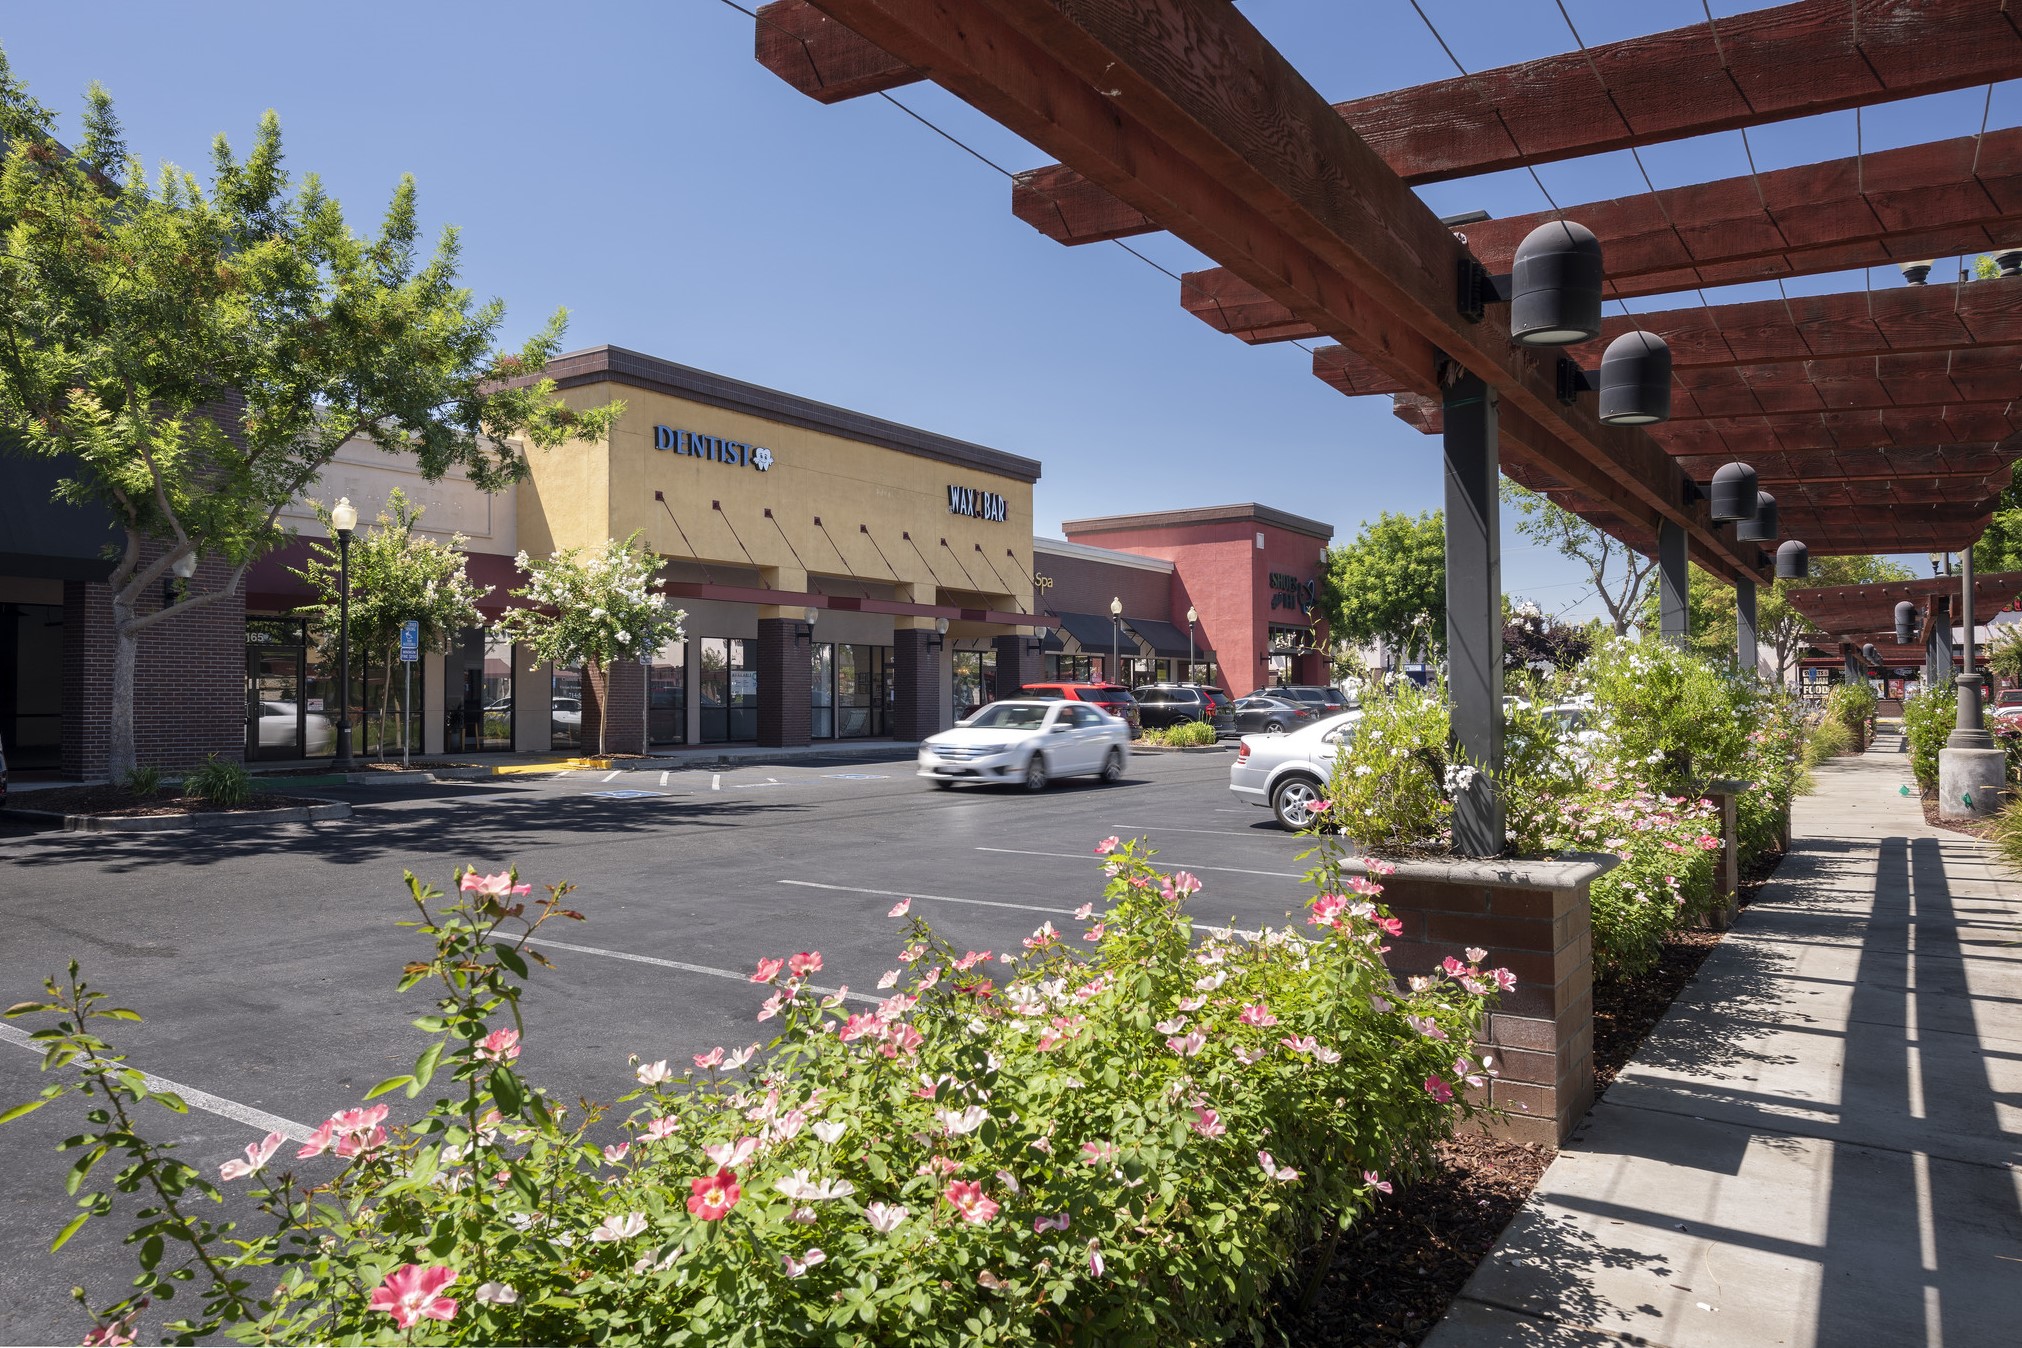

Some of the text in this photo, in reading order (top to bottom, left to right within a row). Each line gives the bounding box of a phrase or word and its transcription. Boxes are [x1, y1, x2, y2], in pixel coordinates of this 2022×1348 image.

[654, 425, 752, 466] DENTIST
[948, 485, 1006, 522] WAX BAR
[1035, 572, 1053, 595] Spa
[245, 632, 264, 642] 165
